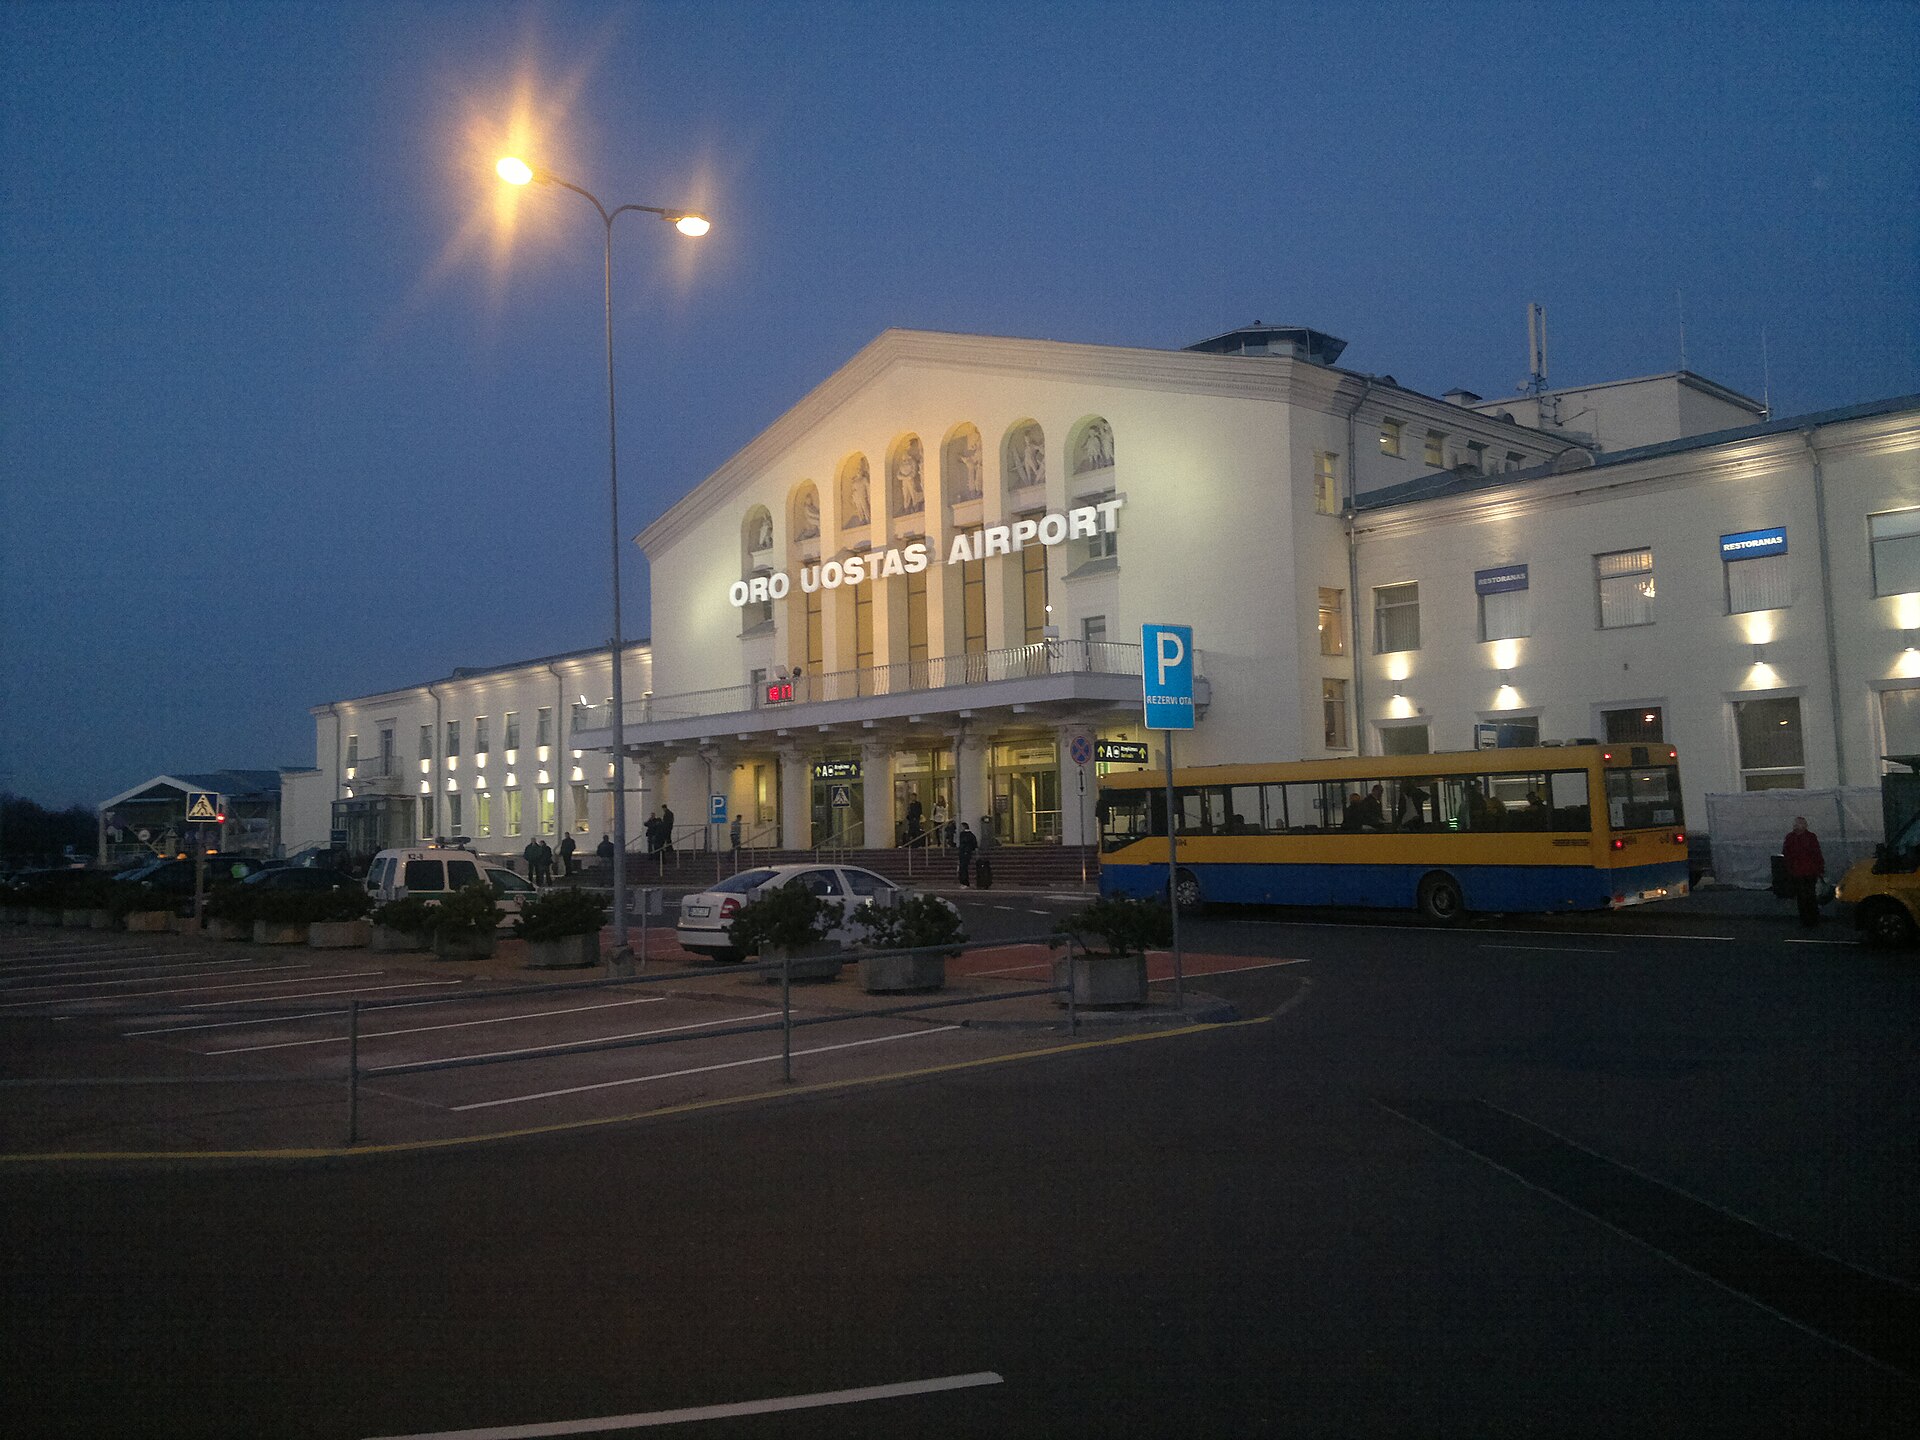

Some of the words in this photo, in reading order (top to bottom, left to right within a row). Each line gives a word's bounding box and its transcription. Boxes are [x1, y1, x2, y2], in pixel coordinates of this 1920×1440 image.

[1723, 536, 1783, 551] RESTORANAS
[729, 572, 789, 607] ORO
[801, 543, 927, 593] UOSTAS
[948, 500, 1123, 565] AIRPORT
[1478, 573, 1526, 586] RESTORANAS
[1157, 632, 1184, 686] P
[712, 797, 724, 815] P
